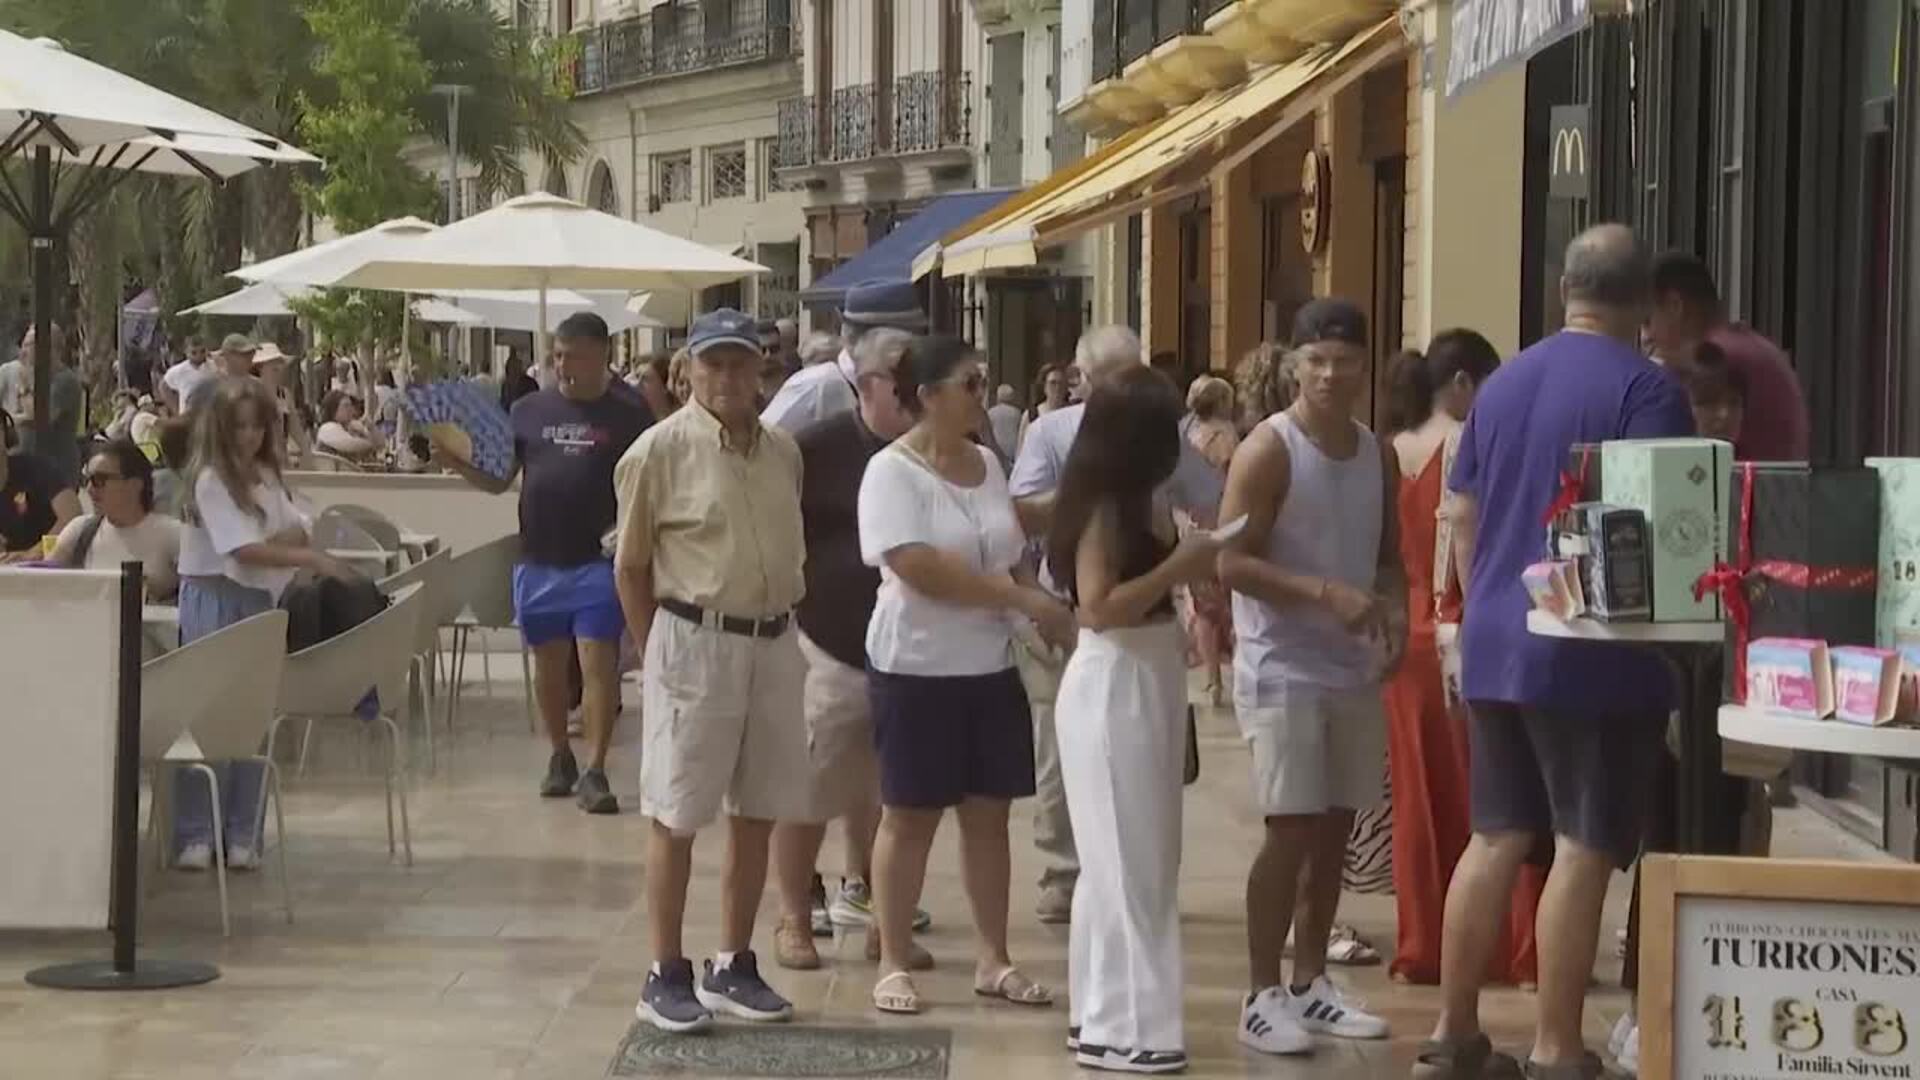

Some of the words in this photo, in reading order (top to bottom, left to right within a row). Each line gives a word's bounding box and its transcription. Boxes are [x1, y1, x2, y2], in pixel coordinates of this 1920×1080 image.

[1815, 986, 1860, 1002] CASA
[1777, 1053, 1843, 1073] Familia
[1846, 1059, 1911, 1079] Sirvent
